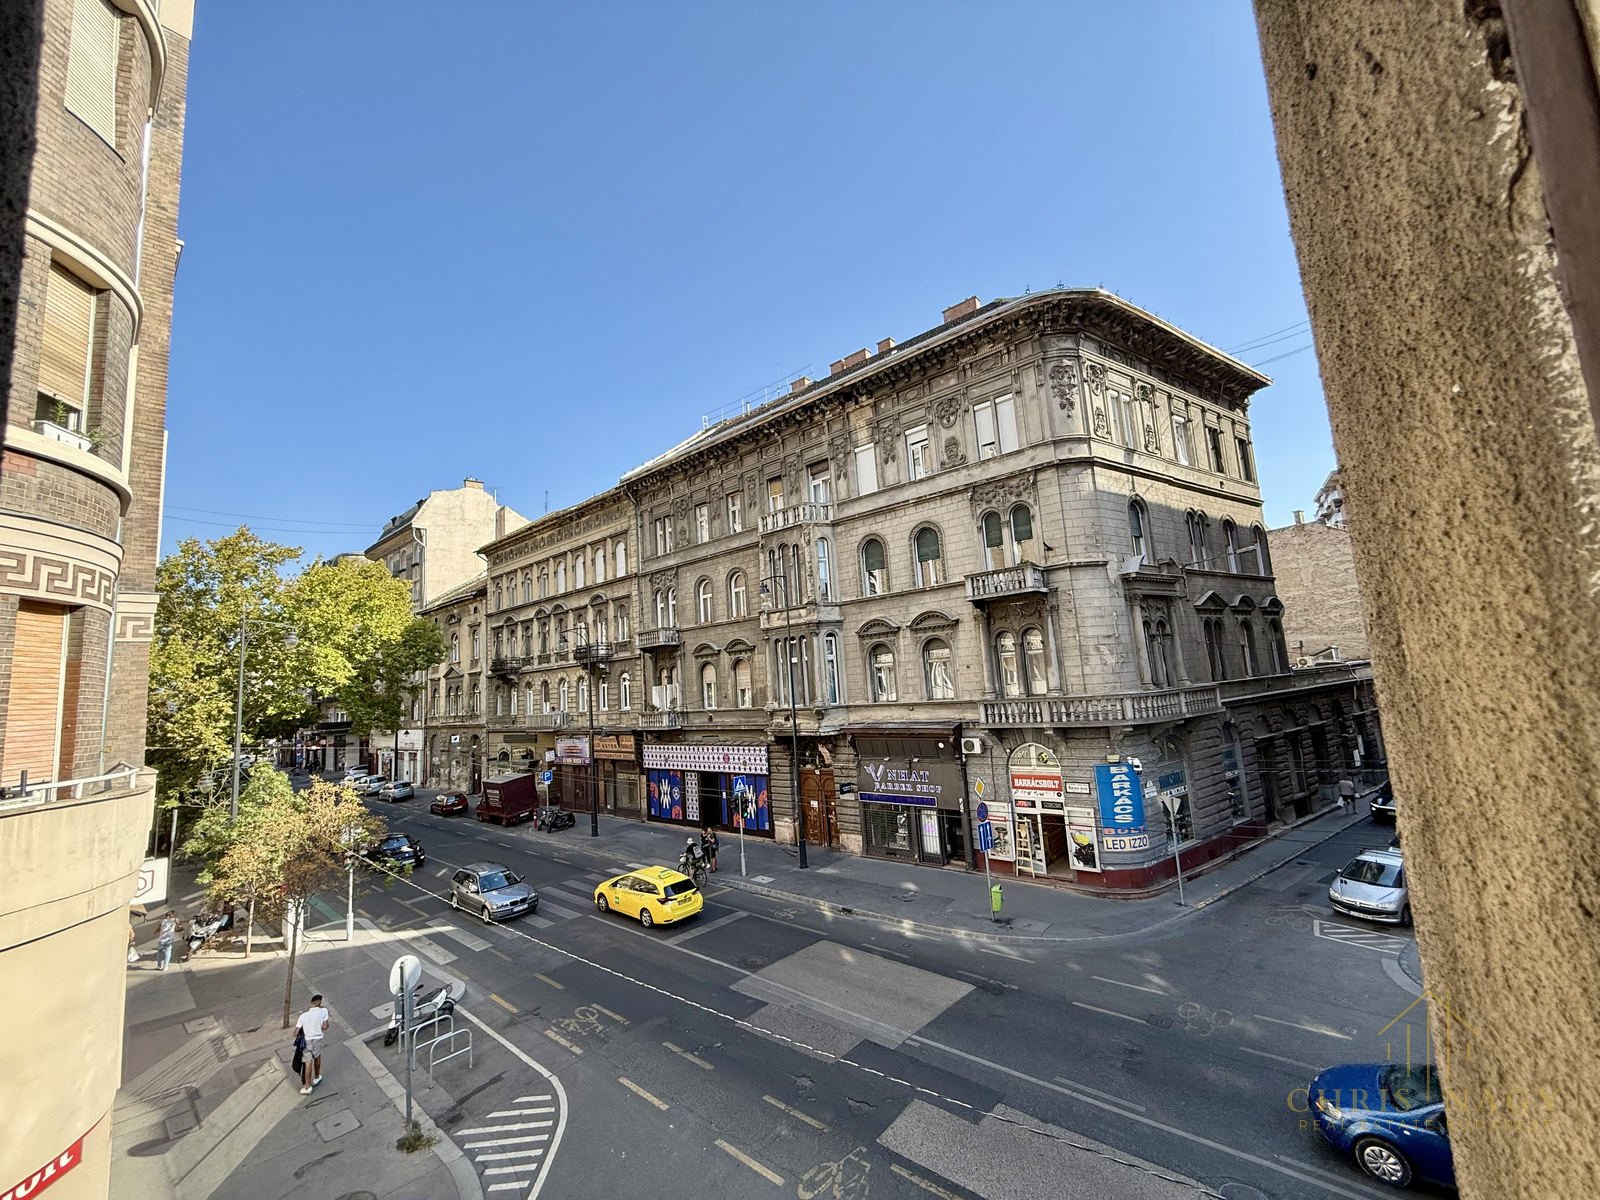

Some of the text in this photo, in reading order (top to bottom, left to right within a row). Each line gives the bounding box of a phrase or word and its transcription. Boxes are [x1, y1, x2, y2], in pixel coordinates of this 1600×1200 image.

[544, 773, 550, 781] P
[916, 784, 943, 794] SHOP
[1105, 839, 1127, 850] LED
